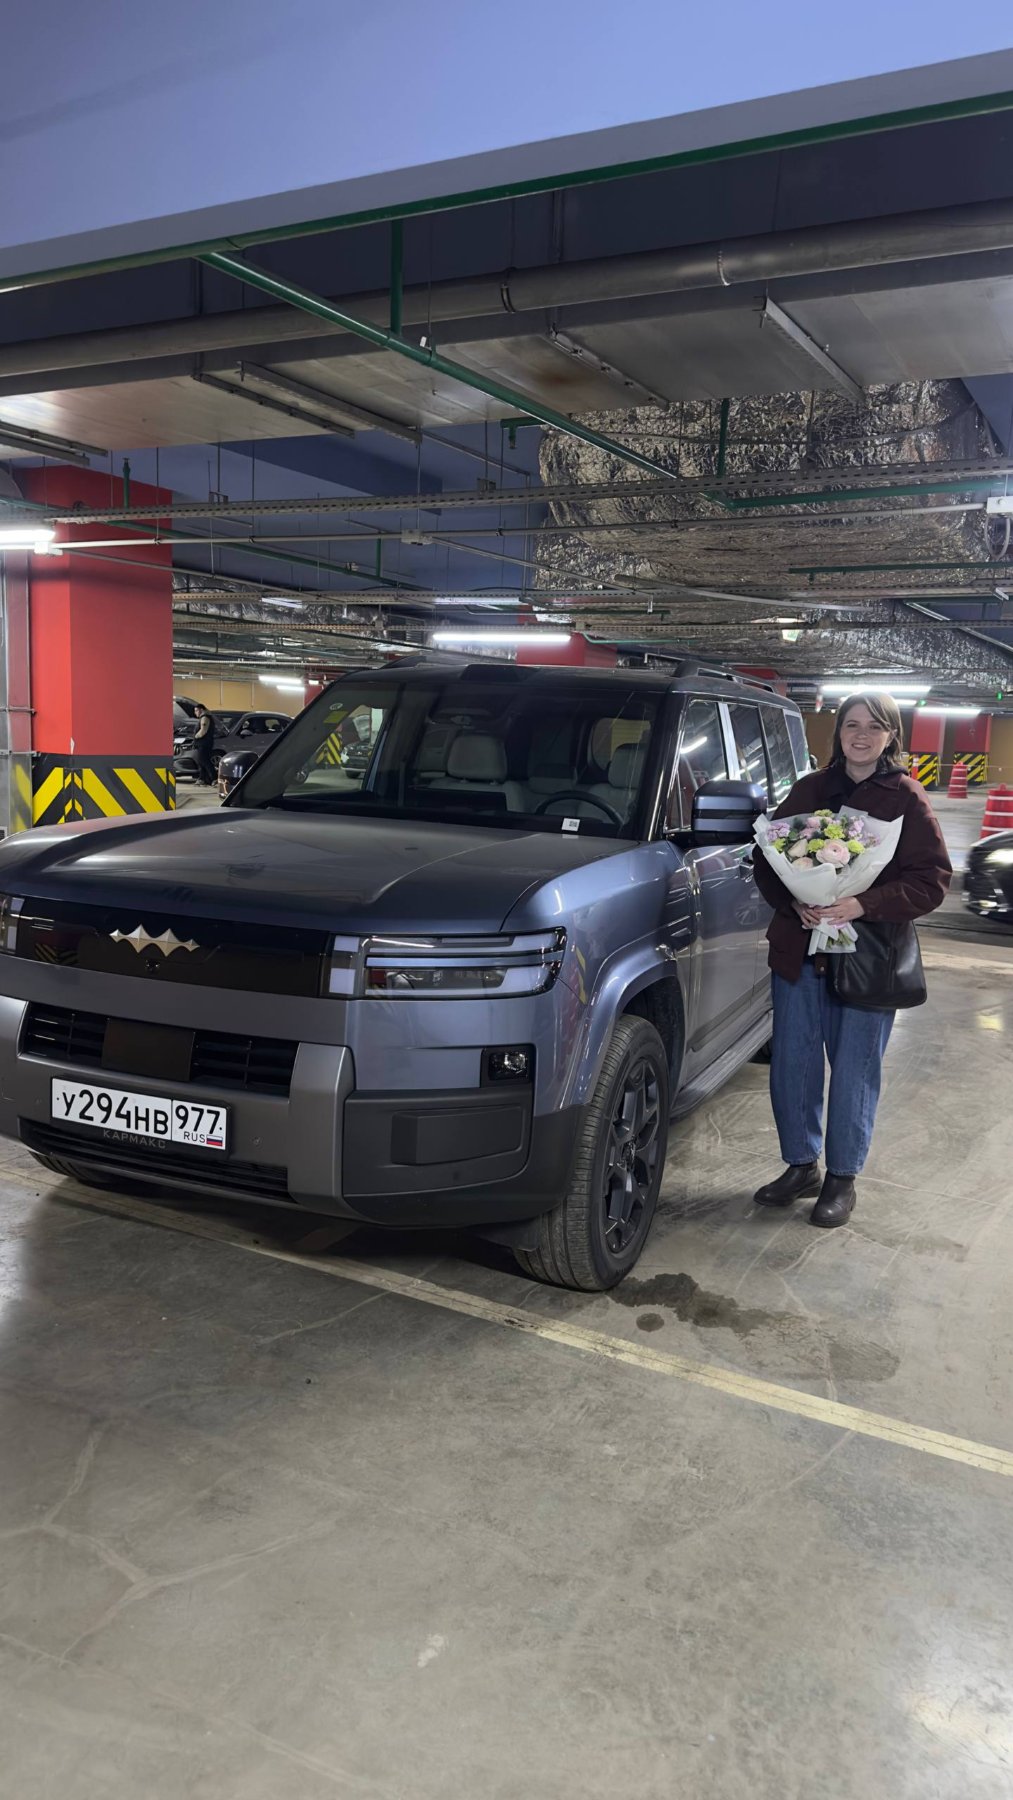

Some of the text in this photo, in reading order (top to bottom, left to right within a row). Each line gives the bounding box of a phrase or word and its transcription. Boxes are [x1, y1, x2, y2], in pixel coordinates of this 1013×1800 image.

[175, 1105, 220, 1134] 977
[103, 1129, 166, 1149] КАРМАКС
[183, 1131, 206, 1143] RUS
